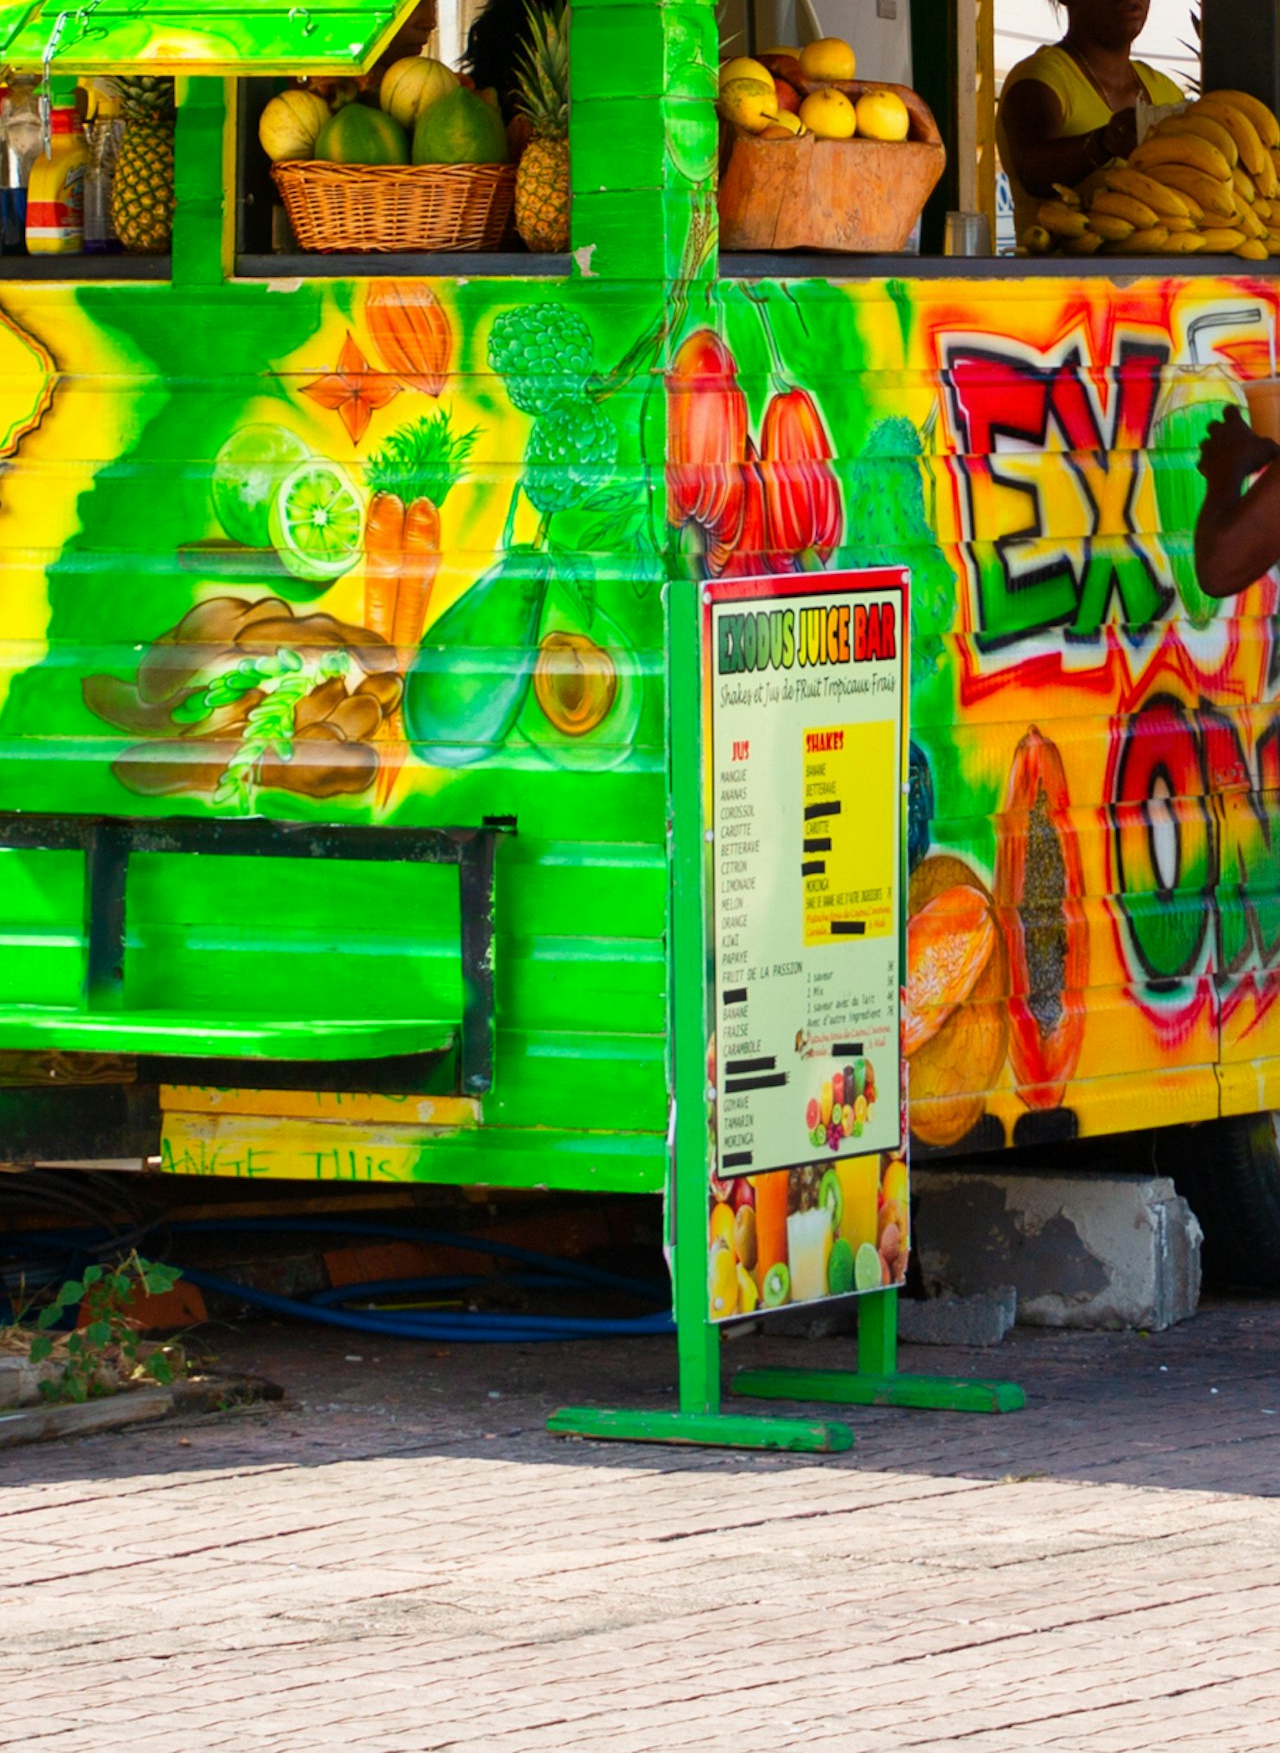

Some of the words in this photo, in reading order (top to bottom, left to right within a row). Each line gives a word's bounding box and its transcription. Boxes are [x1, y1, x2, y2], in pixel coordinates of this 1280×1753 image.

[718, 608, 795, 675] EXODUS
[797, 603, 851, 669] JUICE
[852, 601, 897, 663] BAR
[720, 683, 752, 709] Shakes
[753, 685, 763, 703] et
[763, 681, 780, 708] Jus
[781, 678, 795, 702] de
[822, 675, 870, 704] Tropicaux
[871, 672, 896, 697] Frais
[805, 730, 845, 753] SHAKES
[732, 740, 750, 762] JUS
[721, 768, 748, 784] MANGUE
[721, 786, 748, 802] ANANAS
[721, 804, 756, 821] COROSSOL
[721, 822, 752, 840] CAROTTE
[721, 839, 761, 857] BETTERAVE
[721, 860, 748, 876] CITRON
[721, 877, 757, 894] LIMONADE
[721, 897, 744, 912] MELON
[721, 914, 748, 930] ORANGE
[722, 933, 740, 948] KIWI
[722, 950, 749, 966] PAPAYE
[722, 969, 744, 984] FRUIT
[747, 967, 757, 981] DE
[760, 965, 770, 980] LA
[773, 961, 804, 977] PASSION
[723, 1004, 749, 1021] BANANE
[723, 1023, 750, 1039] FRAISE
[723, 1039, 762, 1058] CARAMBOLE
[723, 1096, 750, 1113] GOYAVE
[724, 1114, 754, 1131] TAMARIN
[724, 1133, 754, 1149] MORINGA
